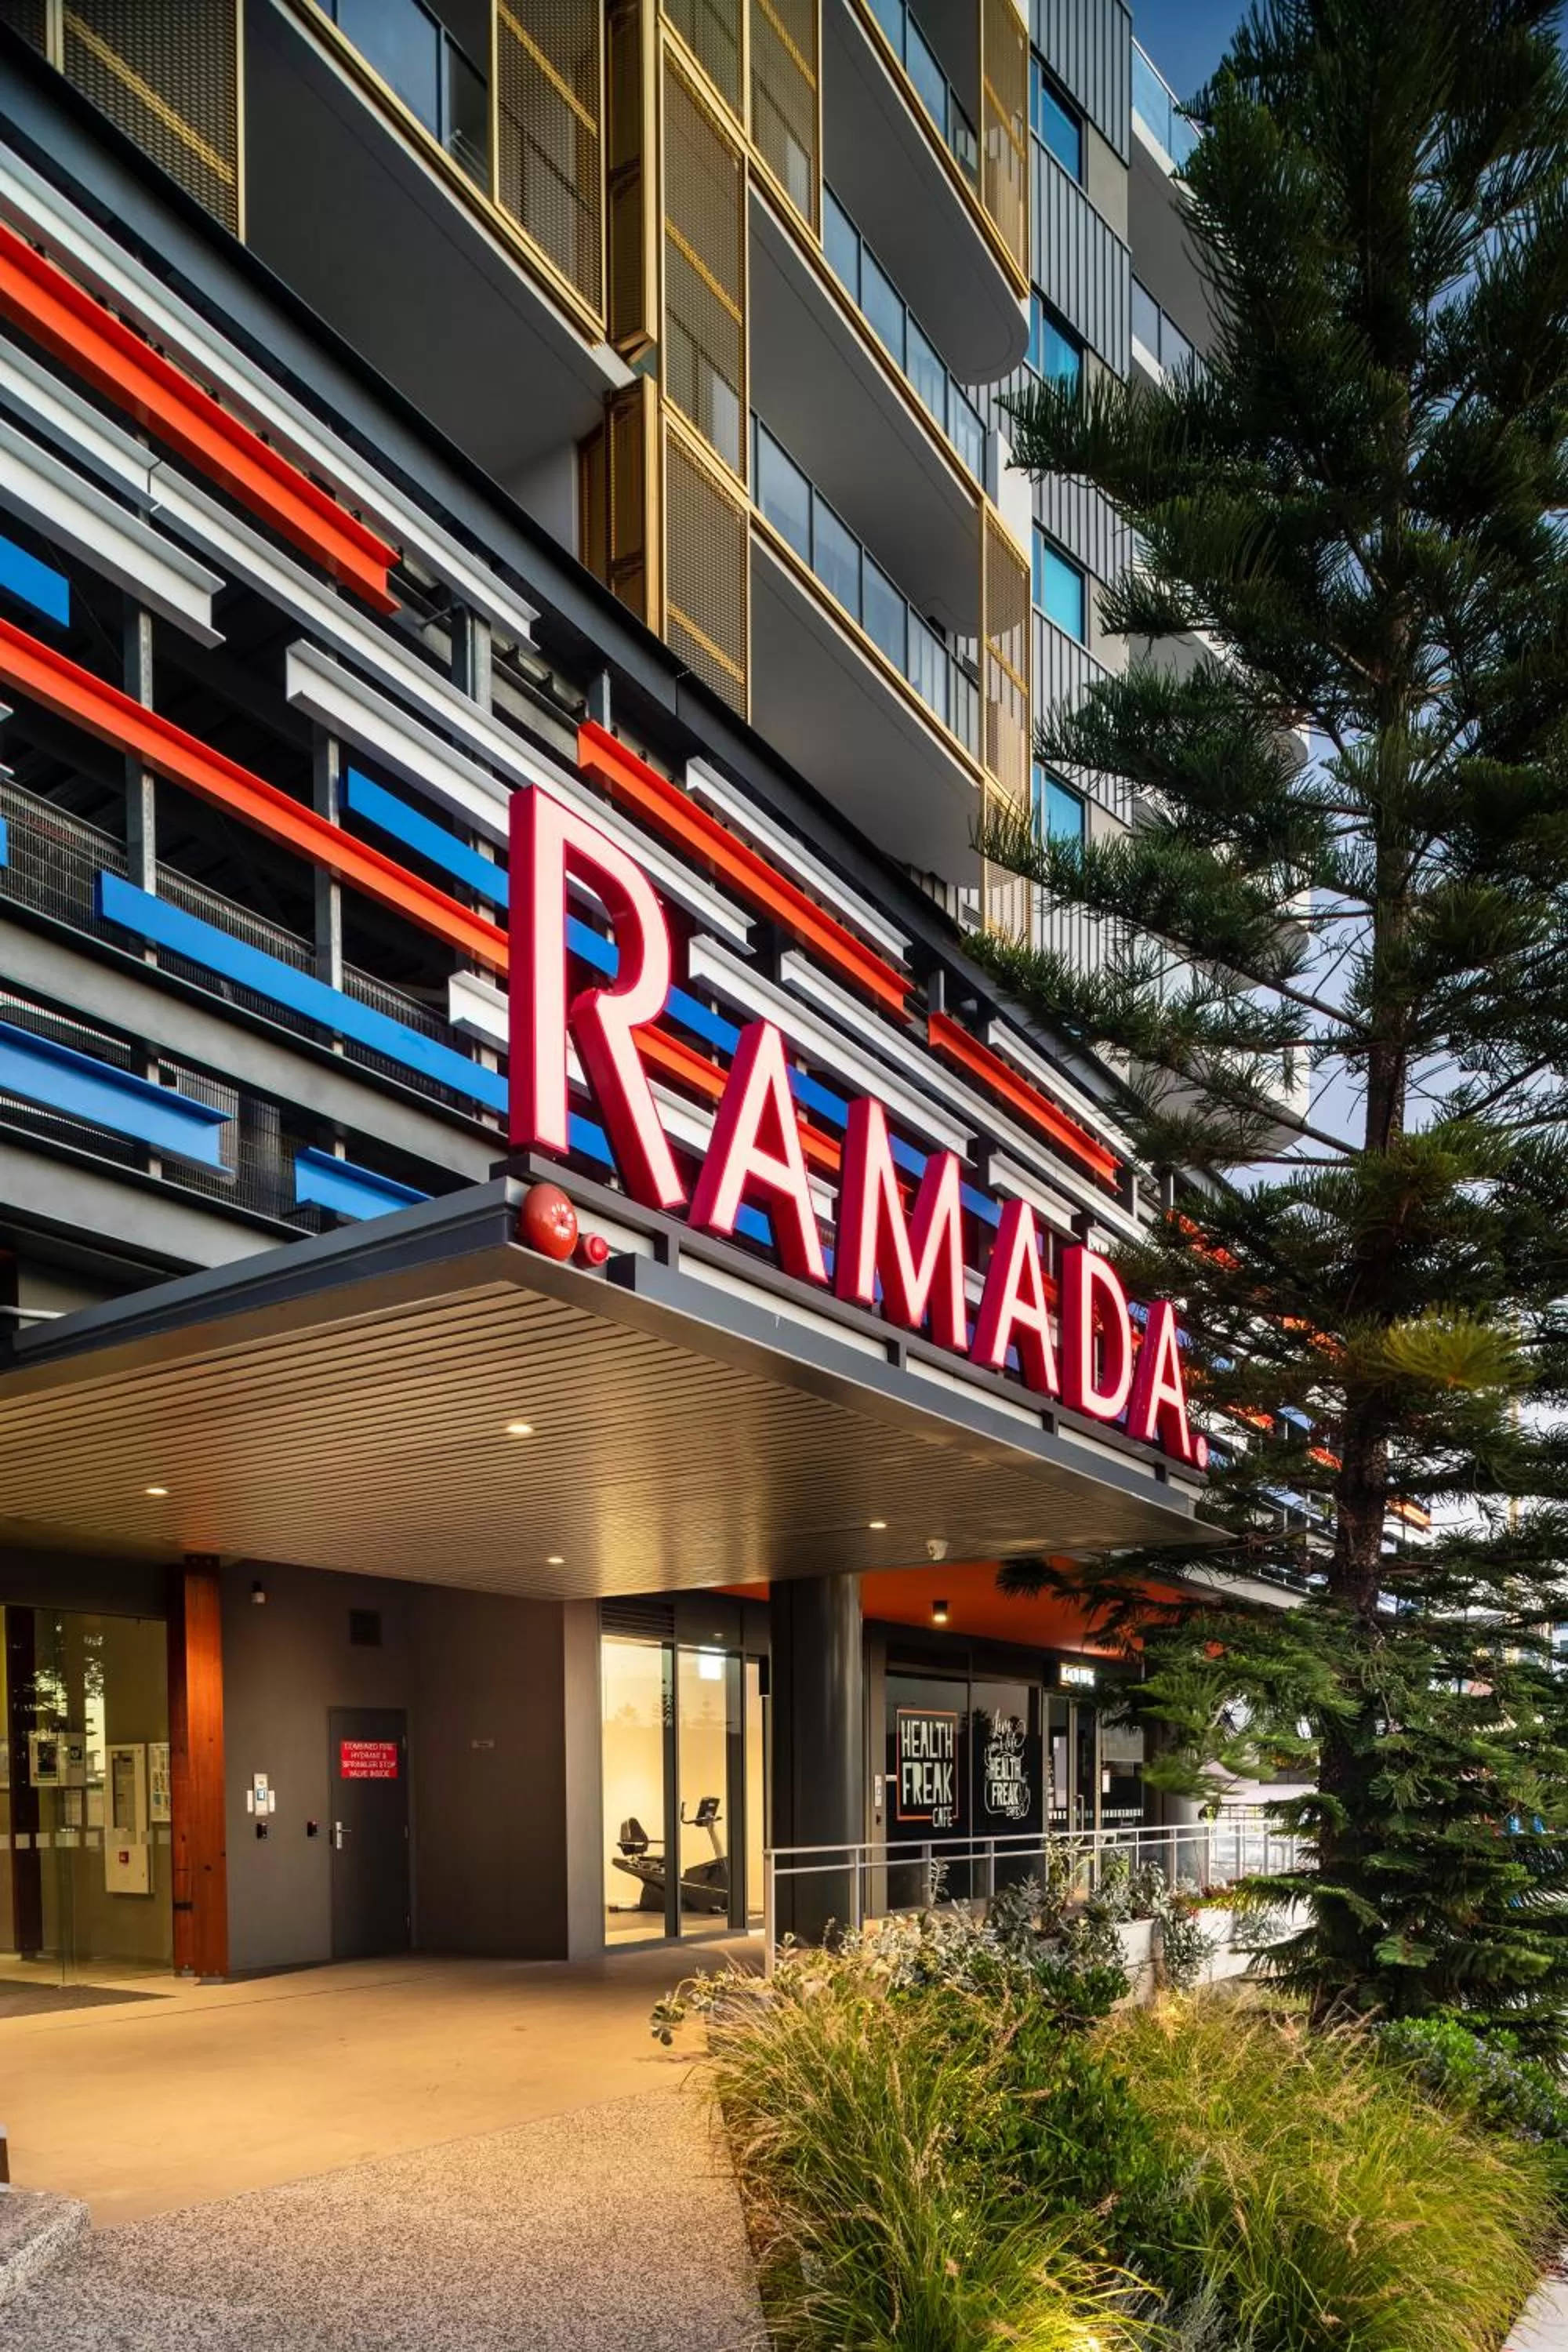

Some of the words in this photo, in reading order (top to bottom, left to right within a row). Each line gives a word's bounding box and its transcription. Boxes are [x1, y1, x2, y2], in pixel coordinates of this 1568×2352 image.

[902, 1720, 953, 1758] HEALTH
[902, 1762, 953, 1805] FREAK
[989, 1757, 1021, 1780] HEALTH
[992, 1782, 1019, 1806] FREAK
